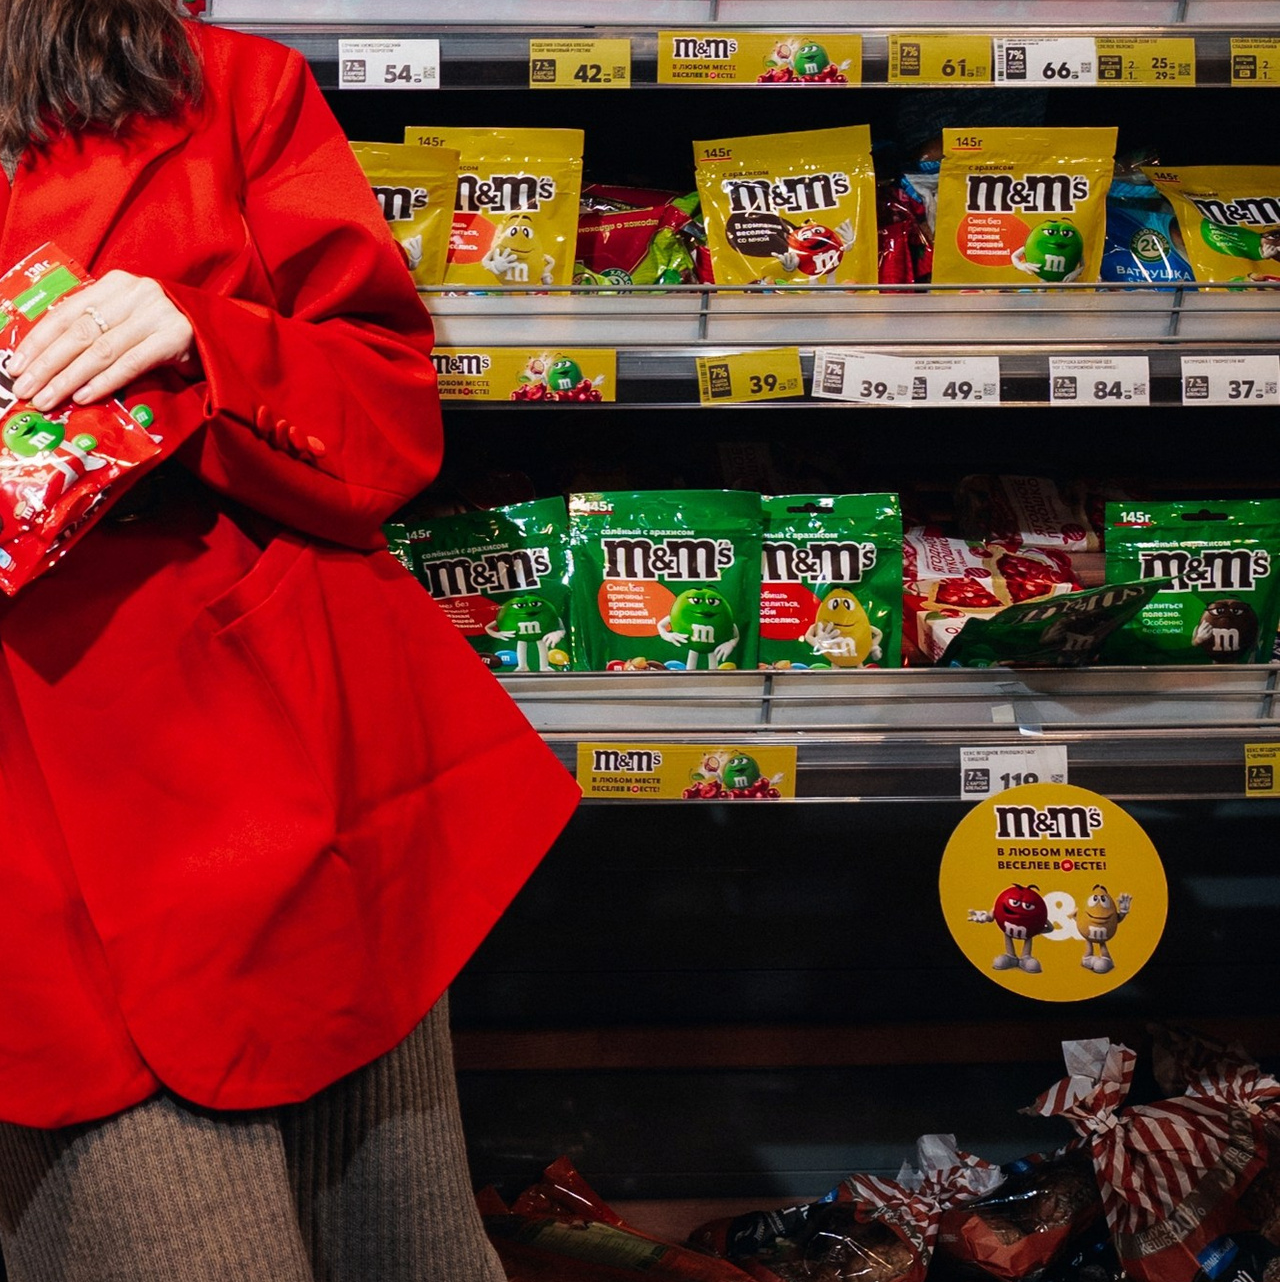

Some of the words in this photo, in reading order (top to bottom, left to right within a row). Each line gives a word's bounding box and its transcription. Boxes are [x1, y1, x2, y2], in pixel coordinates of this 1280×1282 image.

[941, 58, 967, 78] 61
[1042, 62, 1071, 80] 66
[1152, 57, 1168, 69] 25
[384, 64, 412, 83] 54
[574, 64, 602, 83] 42
[1155, 71, 1168, 80] 29
[955, 137, 983, 147] 145г
[703, 147, 732, 159] 145г
[749, 373, 778, 395] 39
[859, 380, 888, 400] 39
[942, 380, 973, 401] 49
[1092, 380, 1122, 400] 84
[1228, 380, 1255, 400] 37
[1120, 512, 1151, 523] 145г
[998, 848, 1004, 856] В
[1008, 848, 1060, 857] ЛЮБОМ
[1065, 848, 1106, 856] МЕСТЕ
[998, 861, 1050, 870] ВЕСЕЛЕЕ
